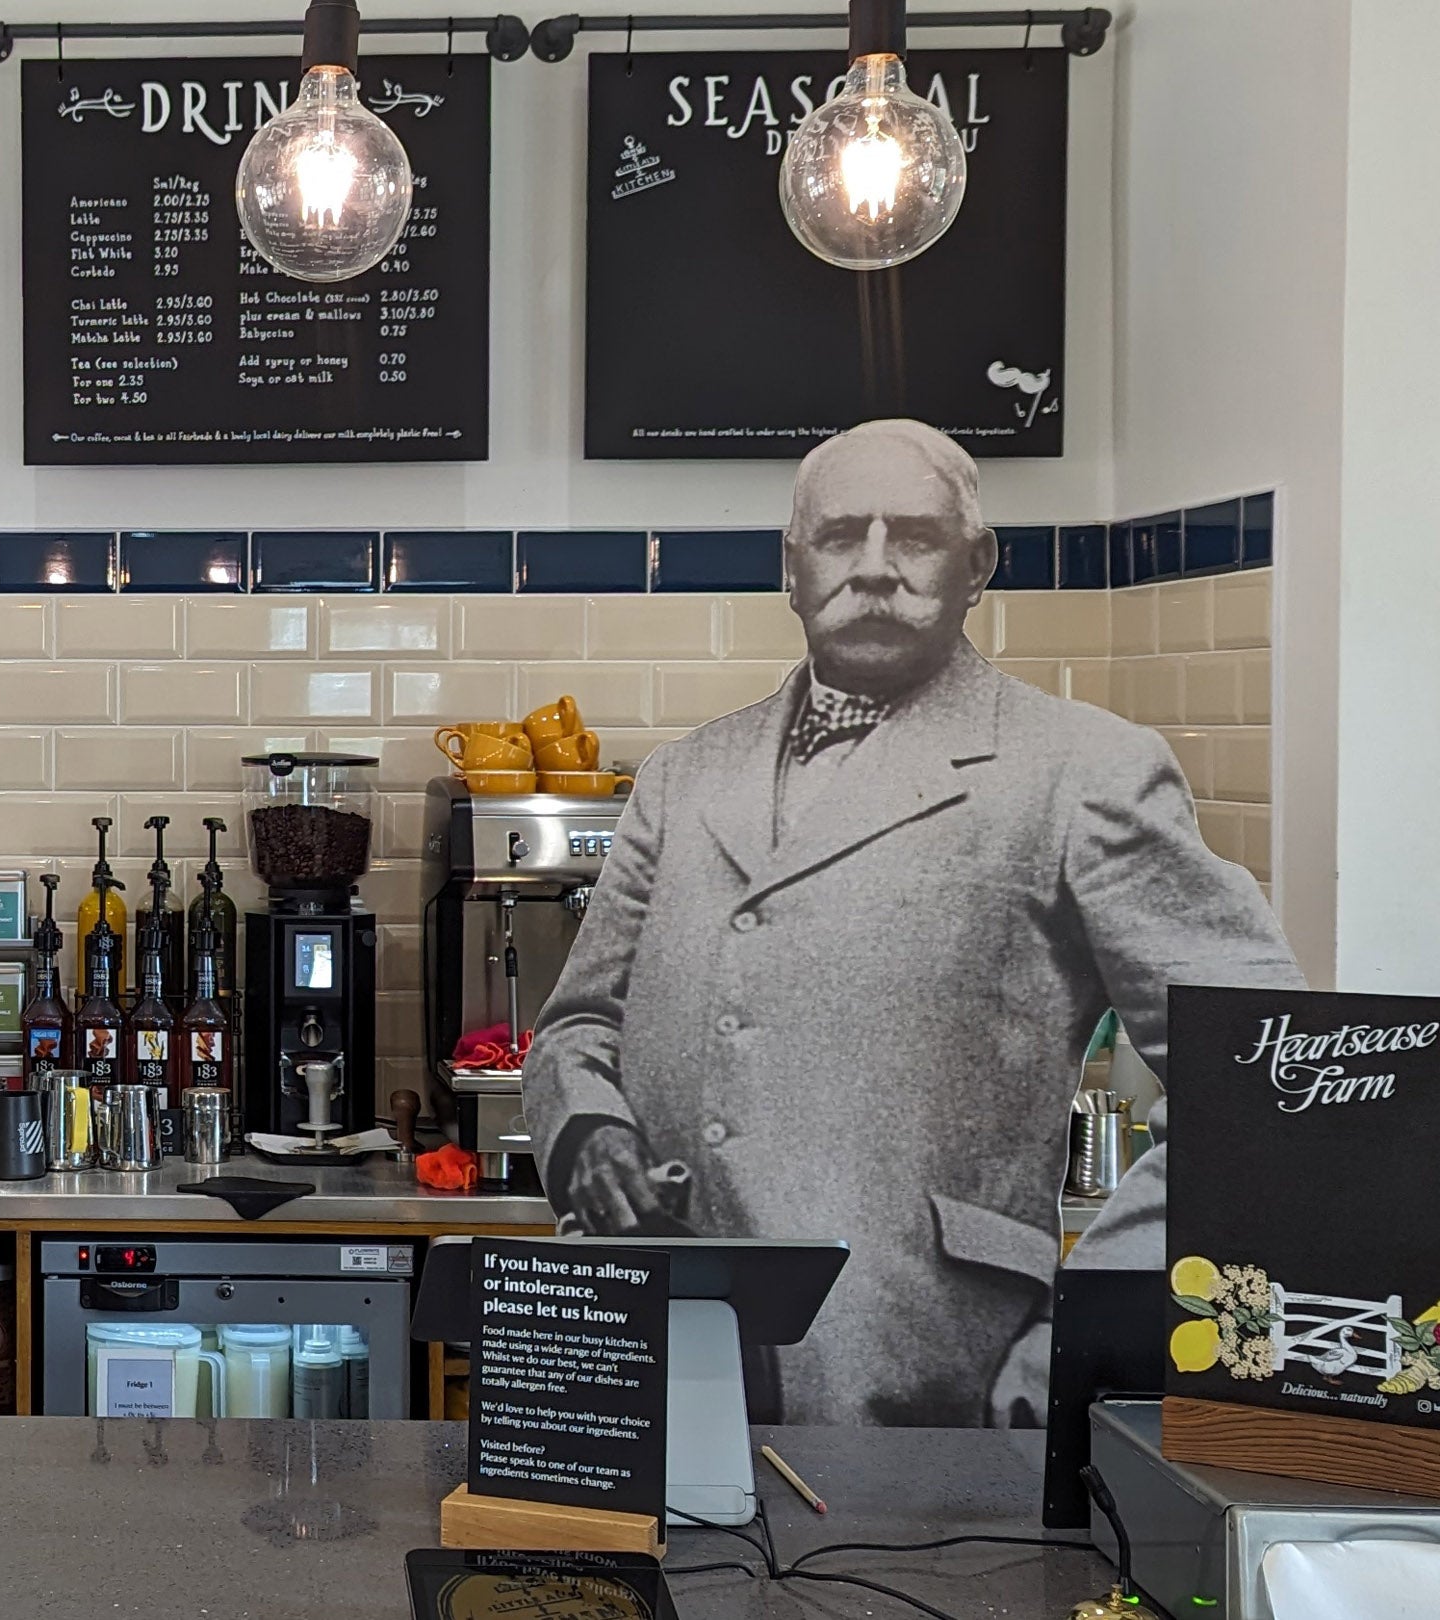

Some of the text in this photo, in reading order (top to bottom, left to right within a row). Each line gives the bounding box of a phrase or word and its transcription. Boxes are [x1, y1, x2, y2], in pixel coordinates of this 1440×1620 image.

[666, 73, 990, 138] SEASAL
[153, 174, 200, 193] Sml/Reg
[616, 169, 669, 194] KITCHEN
[70, 196, 127, 207] Americano
[153, 192, 209, 206] 2.00/2.75
[70, 212, 100, 225] Latte
[153, 210, 209, 224] 2.75/3.35
[70, 231, 132, 247] Cappuccino
[154, 228, 208, 242] 2.75/3.35
[70, 246, 131, 260] Flat White
[154, 246, 178, 258] 3.20
[70, 265, 115, 277] Cortado
[153, 263, 178, 276] 2.95
[71, 298, 127, 310] Chai Latte
[155, 293, 212, 309] 2.95/3.60
[240, 292, 320, 304] Hot Chocolate
[70, 313, 148, 326] Turmeric Latte
[156, 313, 212, 326] 2.95/3.60
[239, 307, 361, 325] plus cream & mallows
[239, 326, 294, 341] Babyccino
[380, 324, 407, 336] 0.75
[70, 356, 177, 369] Tea (see selection)
[238, 354, 348, 370] Add syrup or honey
[378, 352, 406, 364] 0.70
[72, 374, 143, 387] For one 2.35
[238, 371, 264, 387] Soya
[268, 375, 281, 384] or
[308, 370, 333, 383] milk
[379, 370, 406, 382] 0.50
[72, 391, 147, 404] For two 4.50
[1235, 1014, 1440, 1082] Heartsease
[1276, 1064, 1397, 1114] Farm
[484, 1253, 649, 1284] If you have an allergy
[111, 1281, 147, 1289] Osborne
[483, 1276, 598, 1301] or intolerance,
[483, 1297, 627, 1323] please let us know
[482, 1324, 647, 1349] Food made here in our busy kitchen is
[126, 1380, 148, 1389] Fridge
[1281, 1381, 1388, 1409] Delicious... naturally
[480, 1400, 650, 1427] We'd love to help you with your choice
